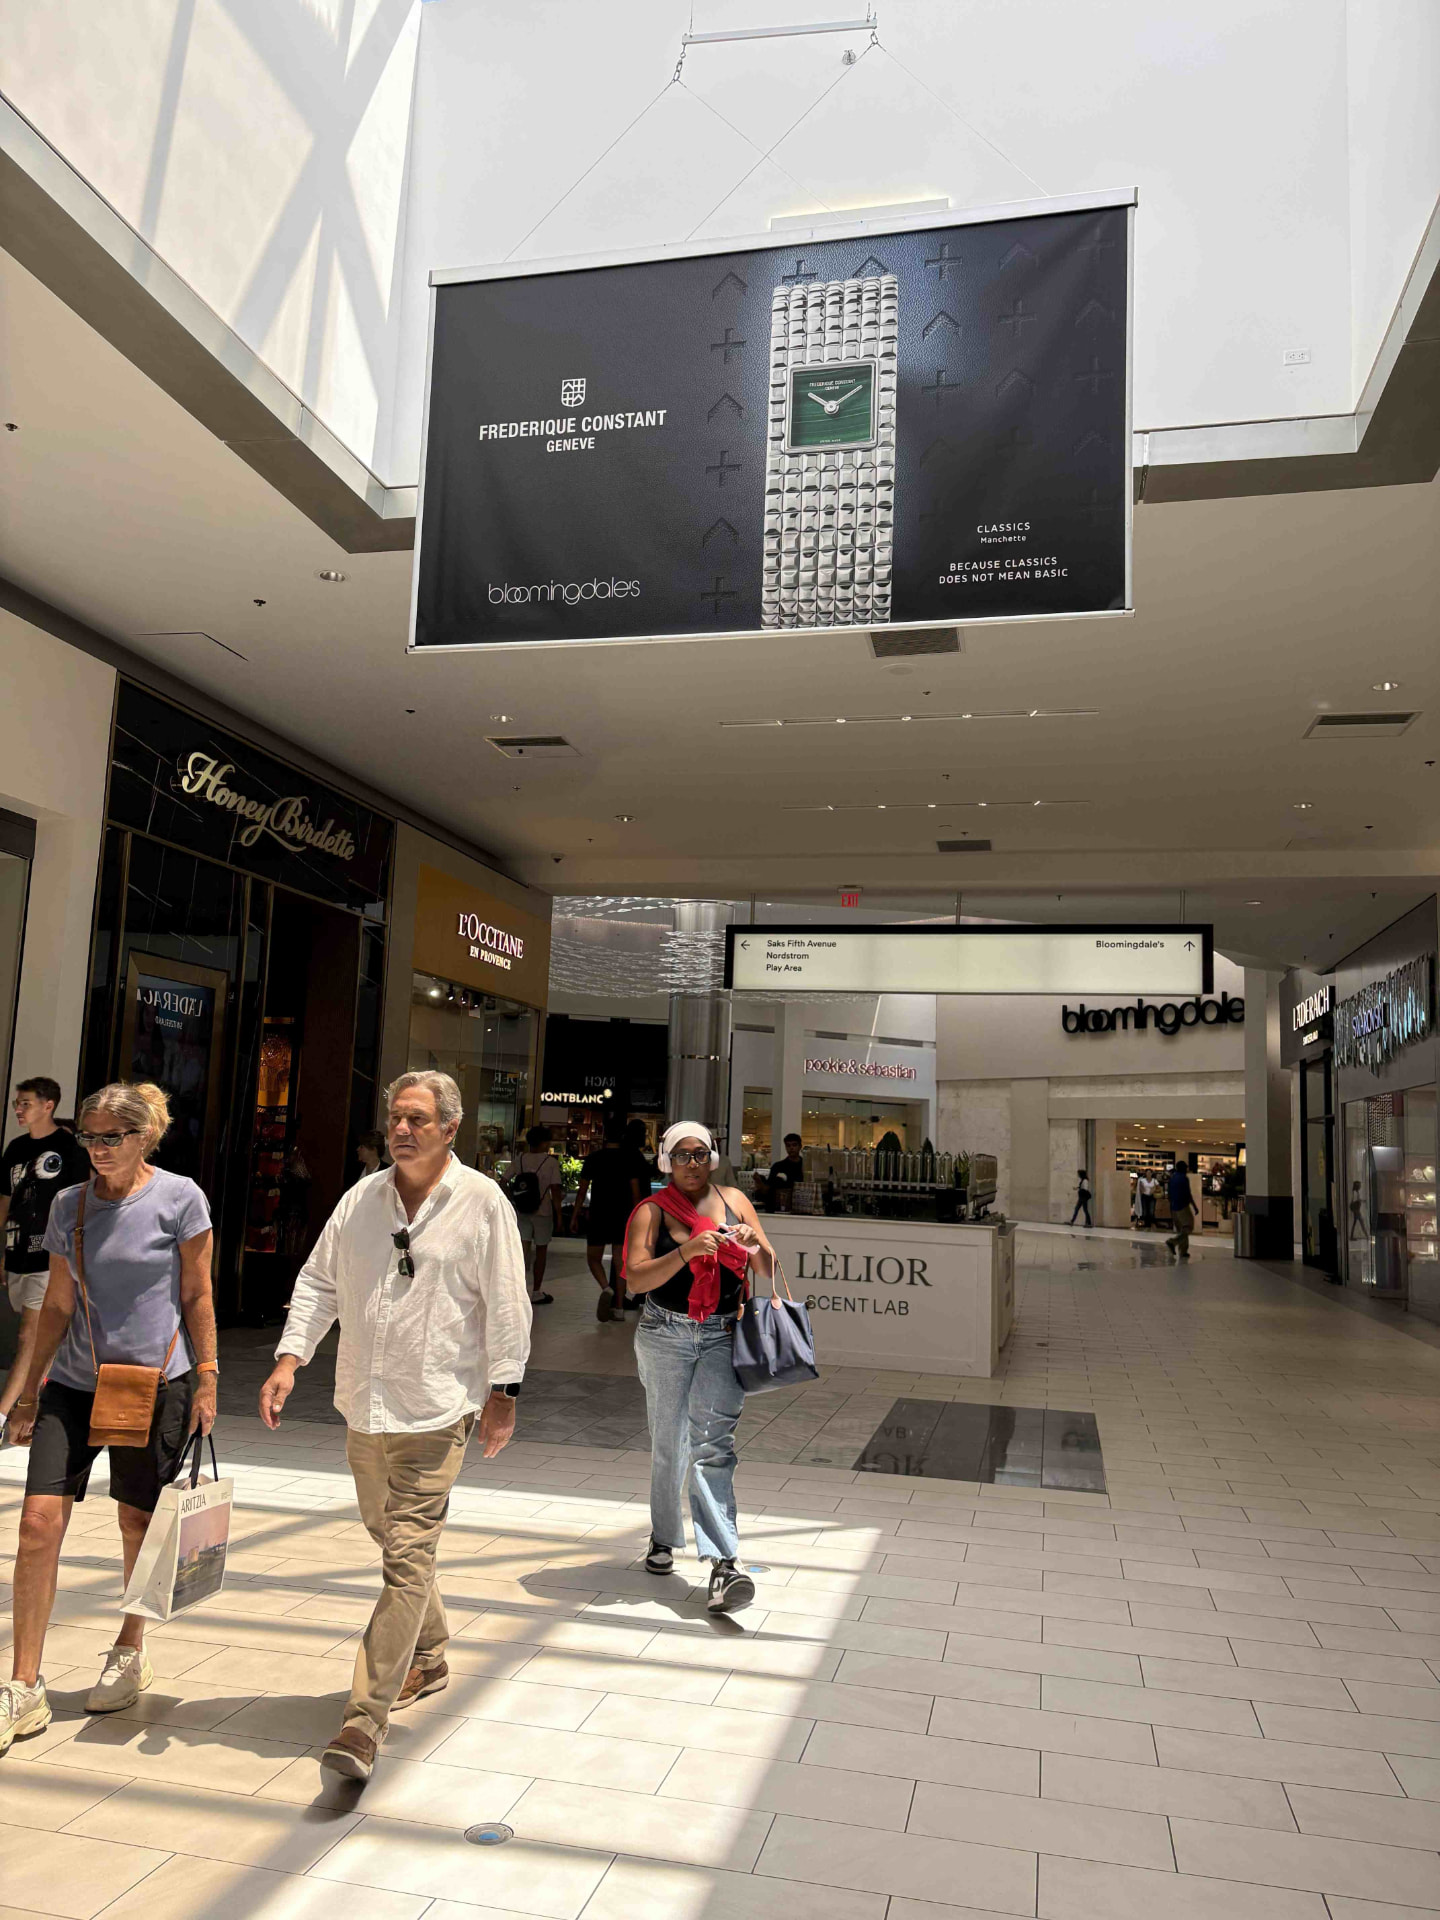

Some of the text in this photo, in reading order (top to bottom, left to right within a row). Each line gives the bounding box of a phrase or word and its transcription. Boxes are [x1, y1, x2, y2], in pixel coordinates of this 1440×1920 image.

[479, 409, 667, 441] FREDERIQUE CONSTANT
[546, 437, 595, 453] GENEVE
[976, 522, 1031, 534] CLASSICS
[980, 535, 1027, 544] Manchette
[949, 556, 1058, 572] BECAUSE CLASSICS
[939, 568, 1069, 584] DOES NOT MEAN BASIC
[488, 576, 641, 606] bloomingdale's
[181, 751, 356, 861] Honey Birdette
[841, 893, 859, 908] EXIT
[457, 913, 524, 959] L'OCCITANE
[767, 939, 837, 948] Saks Fifth Avenue
[1095, 940, 1165, 950] Bloomingdale's
[469, 945, 512, 970] EN PROVENCE
[766, 952, 809, 960] Nordstrom
[766, 964, 802, 973] Play Area
[858, 1061, 917, 1080] sebastian
[795, 1245, 934, 1287] LÈLIOR
[806, 1294, 910, 1316] SCENT LAB
[180, 1494, 207, 1514] ARITZIA
